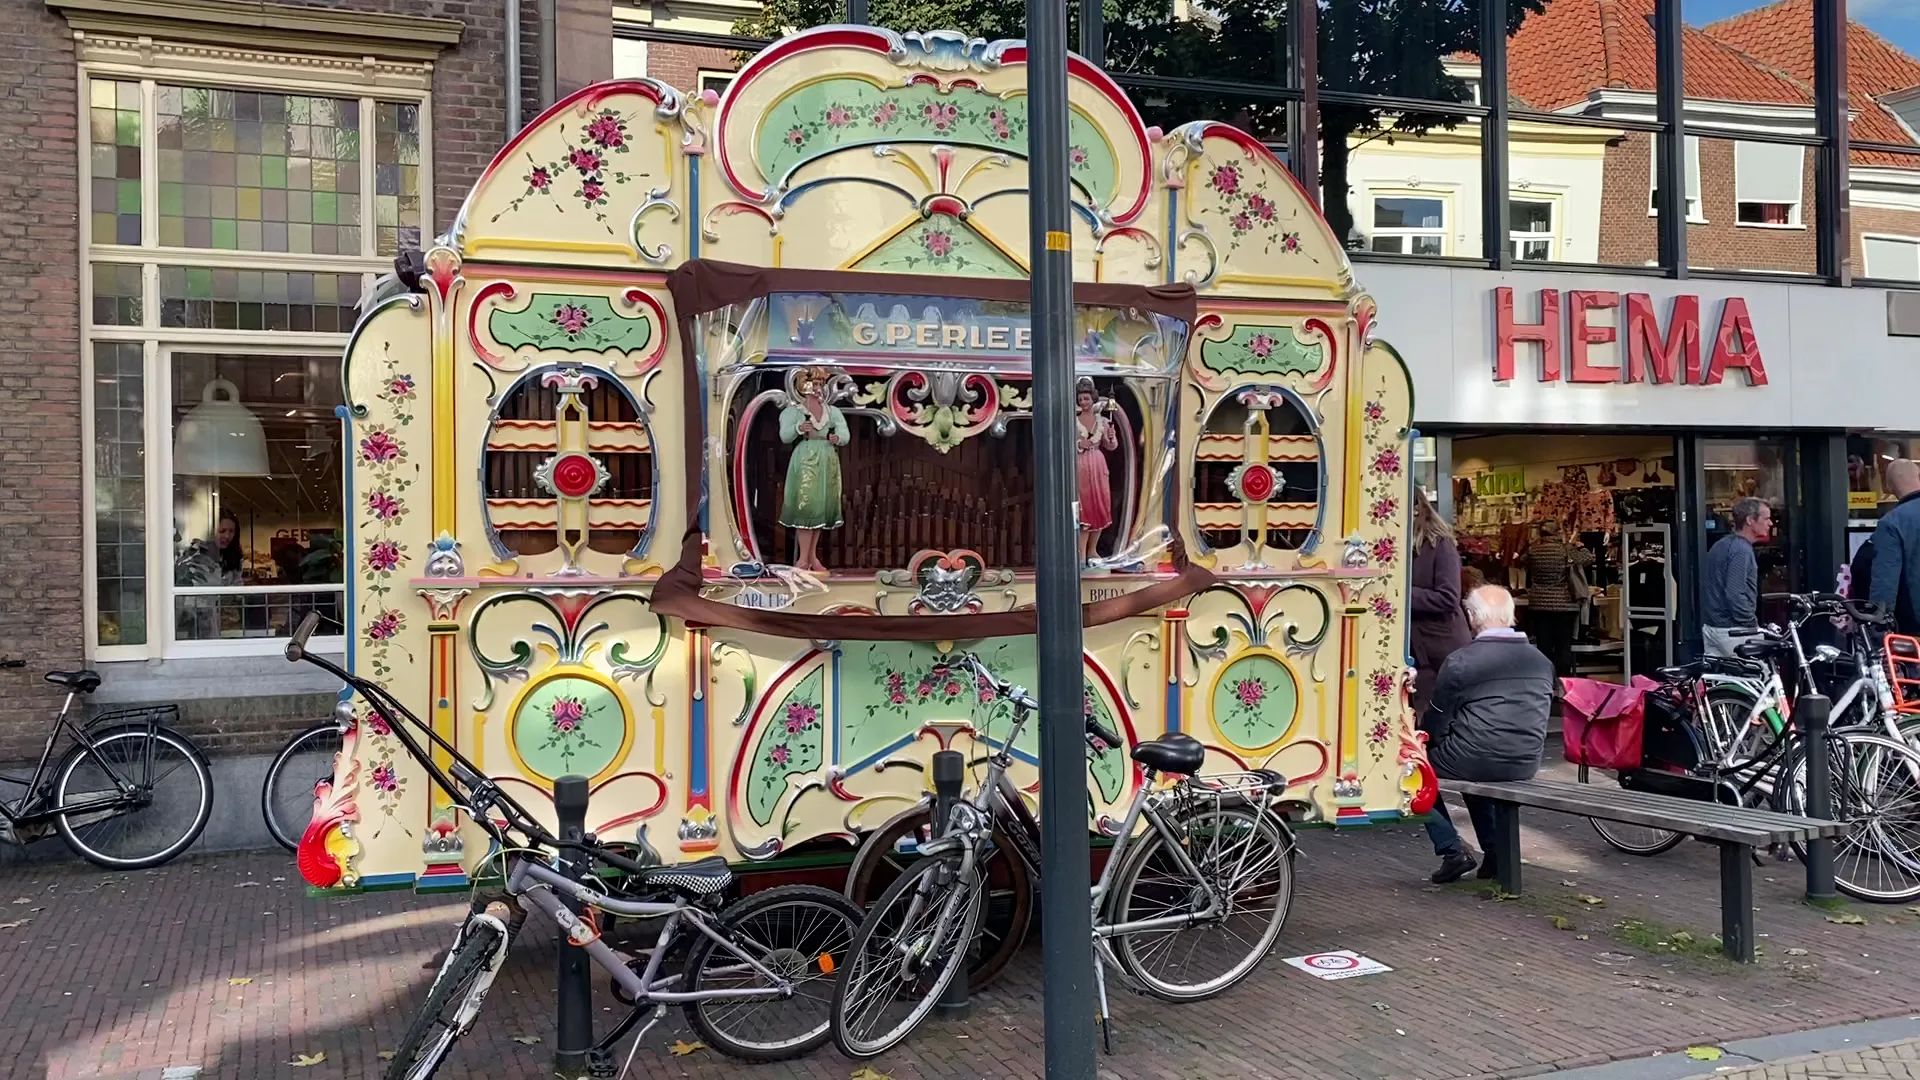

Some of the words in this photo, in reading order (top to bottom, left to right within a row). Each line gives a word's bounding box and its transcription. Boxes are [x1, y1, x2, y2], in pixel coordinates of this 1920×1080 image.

[1492, 286, 1768, 387] HEMA
[1476, 466, 1525, 496] kind
[735, 592, 764, 607] CARL
